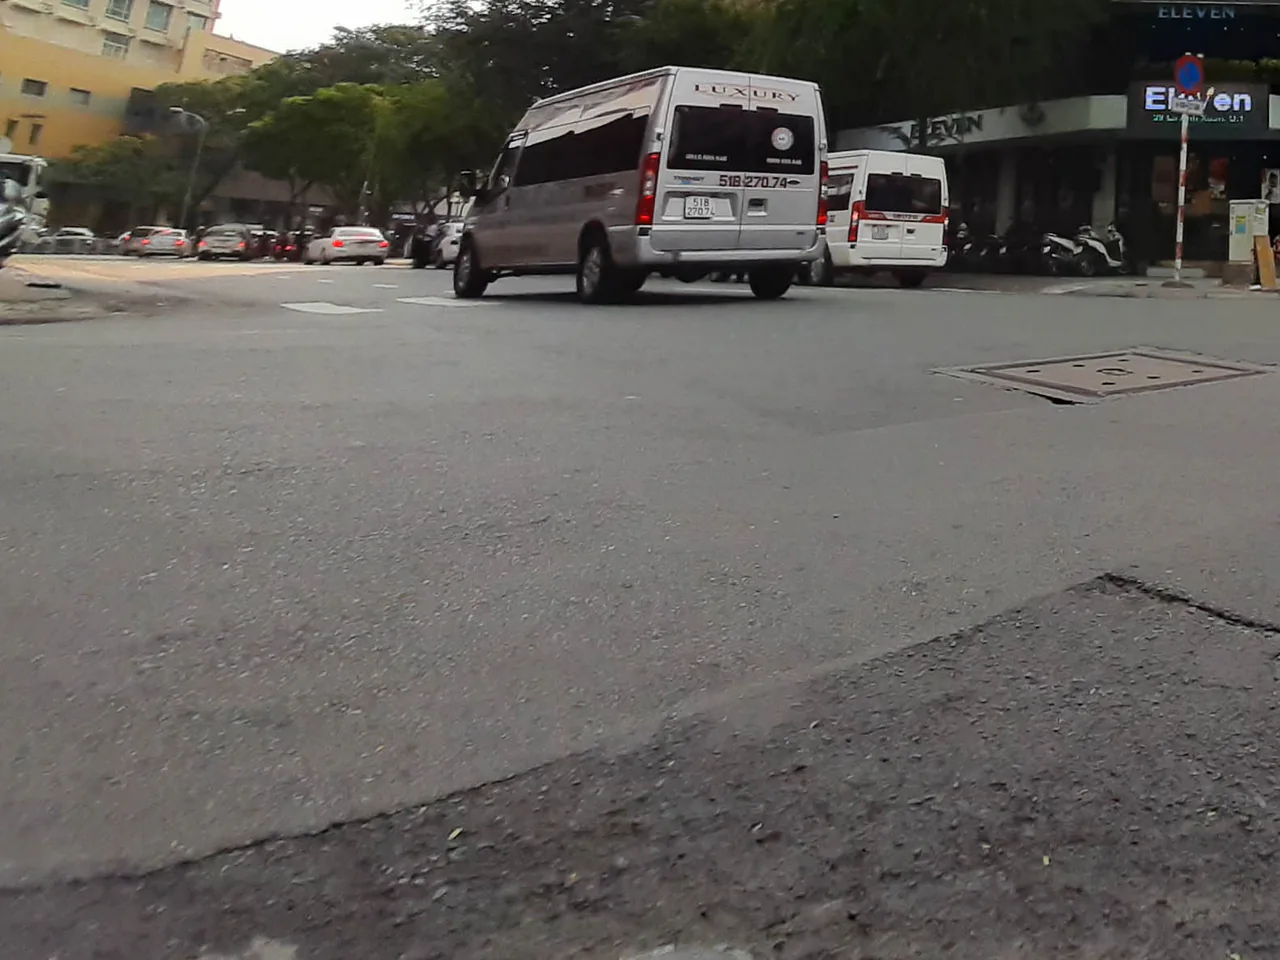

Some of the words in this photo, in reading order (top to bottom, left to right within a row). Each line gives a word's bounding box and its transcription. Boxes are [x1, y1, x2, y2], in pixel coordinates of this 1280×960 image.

[1158, 5, 1236, 19] ELEVEN
[694, 84, 800, 102] LUXURY
[693, 197, 710, 207] 51B
